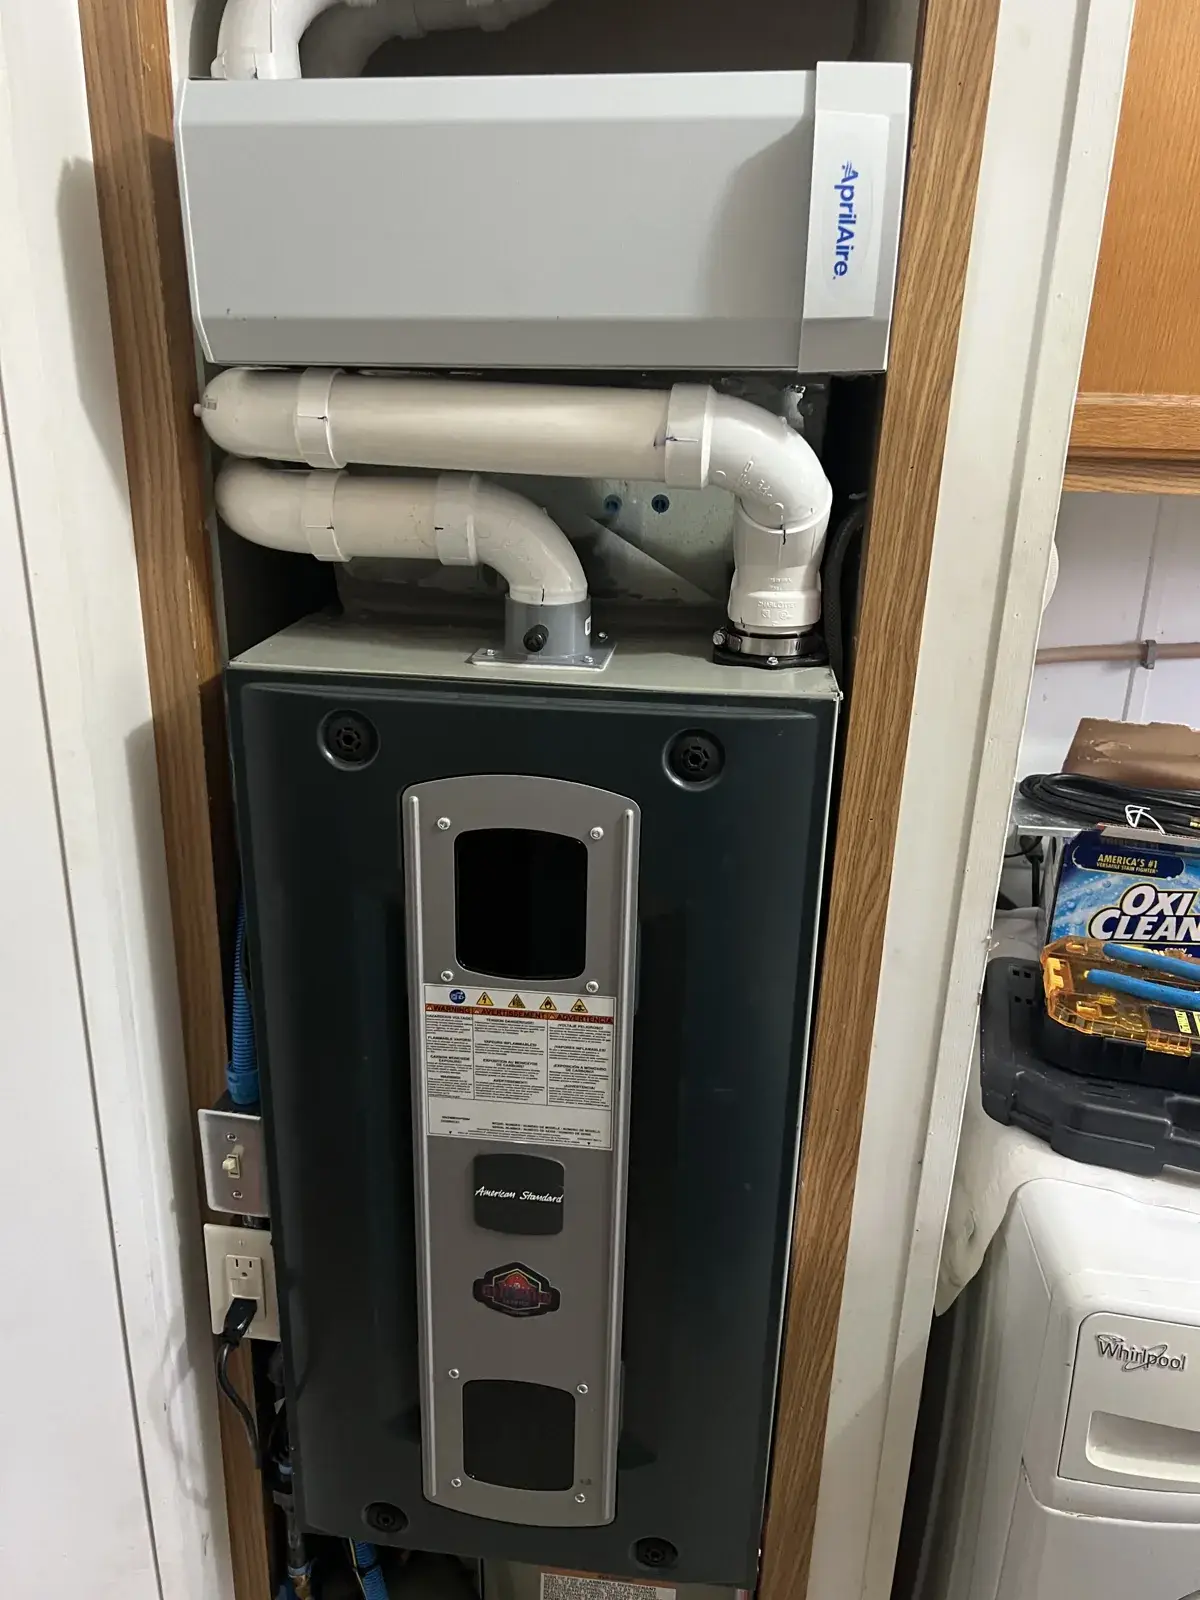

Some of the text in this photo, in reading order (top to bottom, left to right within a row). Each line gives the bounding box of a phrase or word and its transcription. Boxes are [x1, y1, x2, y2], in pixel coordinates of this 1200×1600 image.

[834, 161, 859, 277] AprilAire
[1097, 854, 1158, 869] AMERICA'S #1
[1121, 884, 1194, 916] OXI
[1090, 908, 1200, 941] CLEAN
[434, 1005, 471, 1014] WARNING
[474, 1185, 564, 1204] American Standard
[1097, 1334, 1186, 1371] Whirlpool
